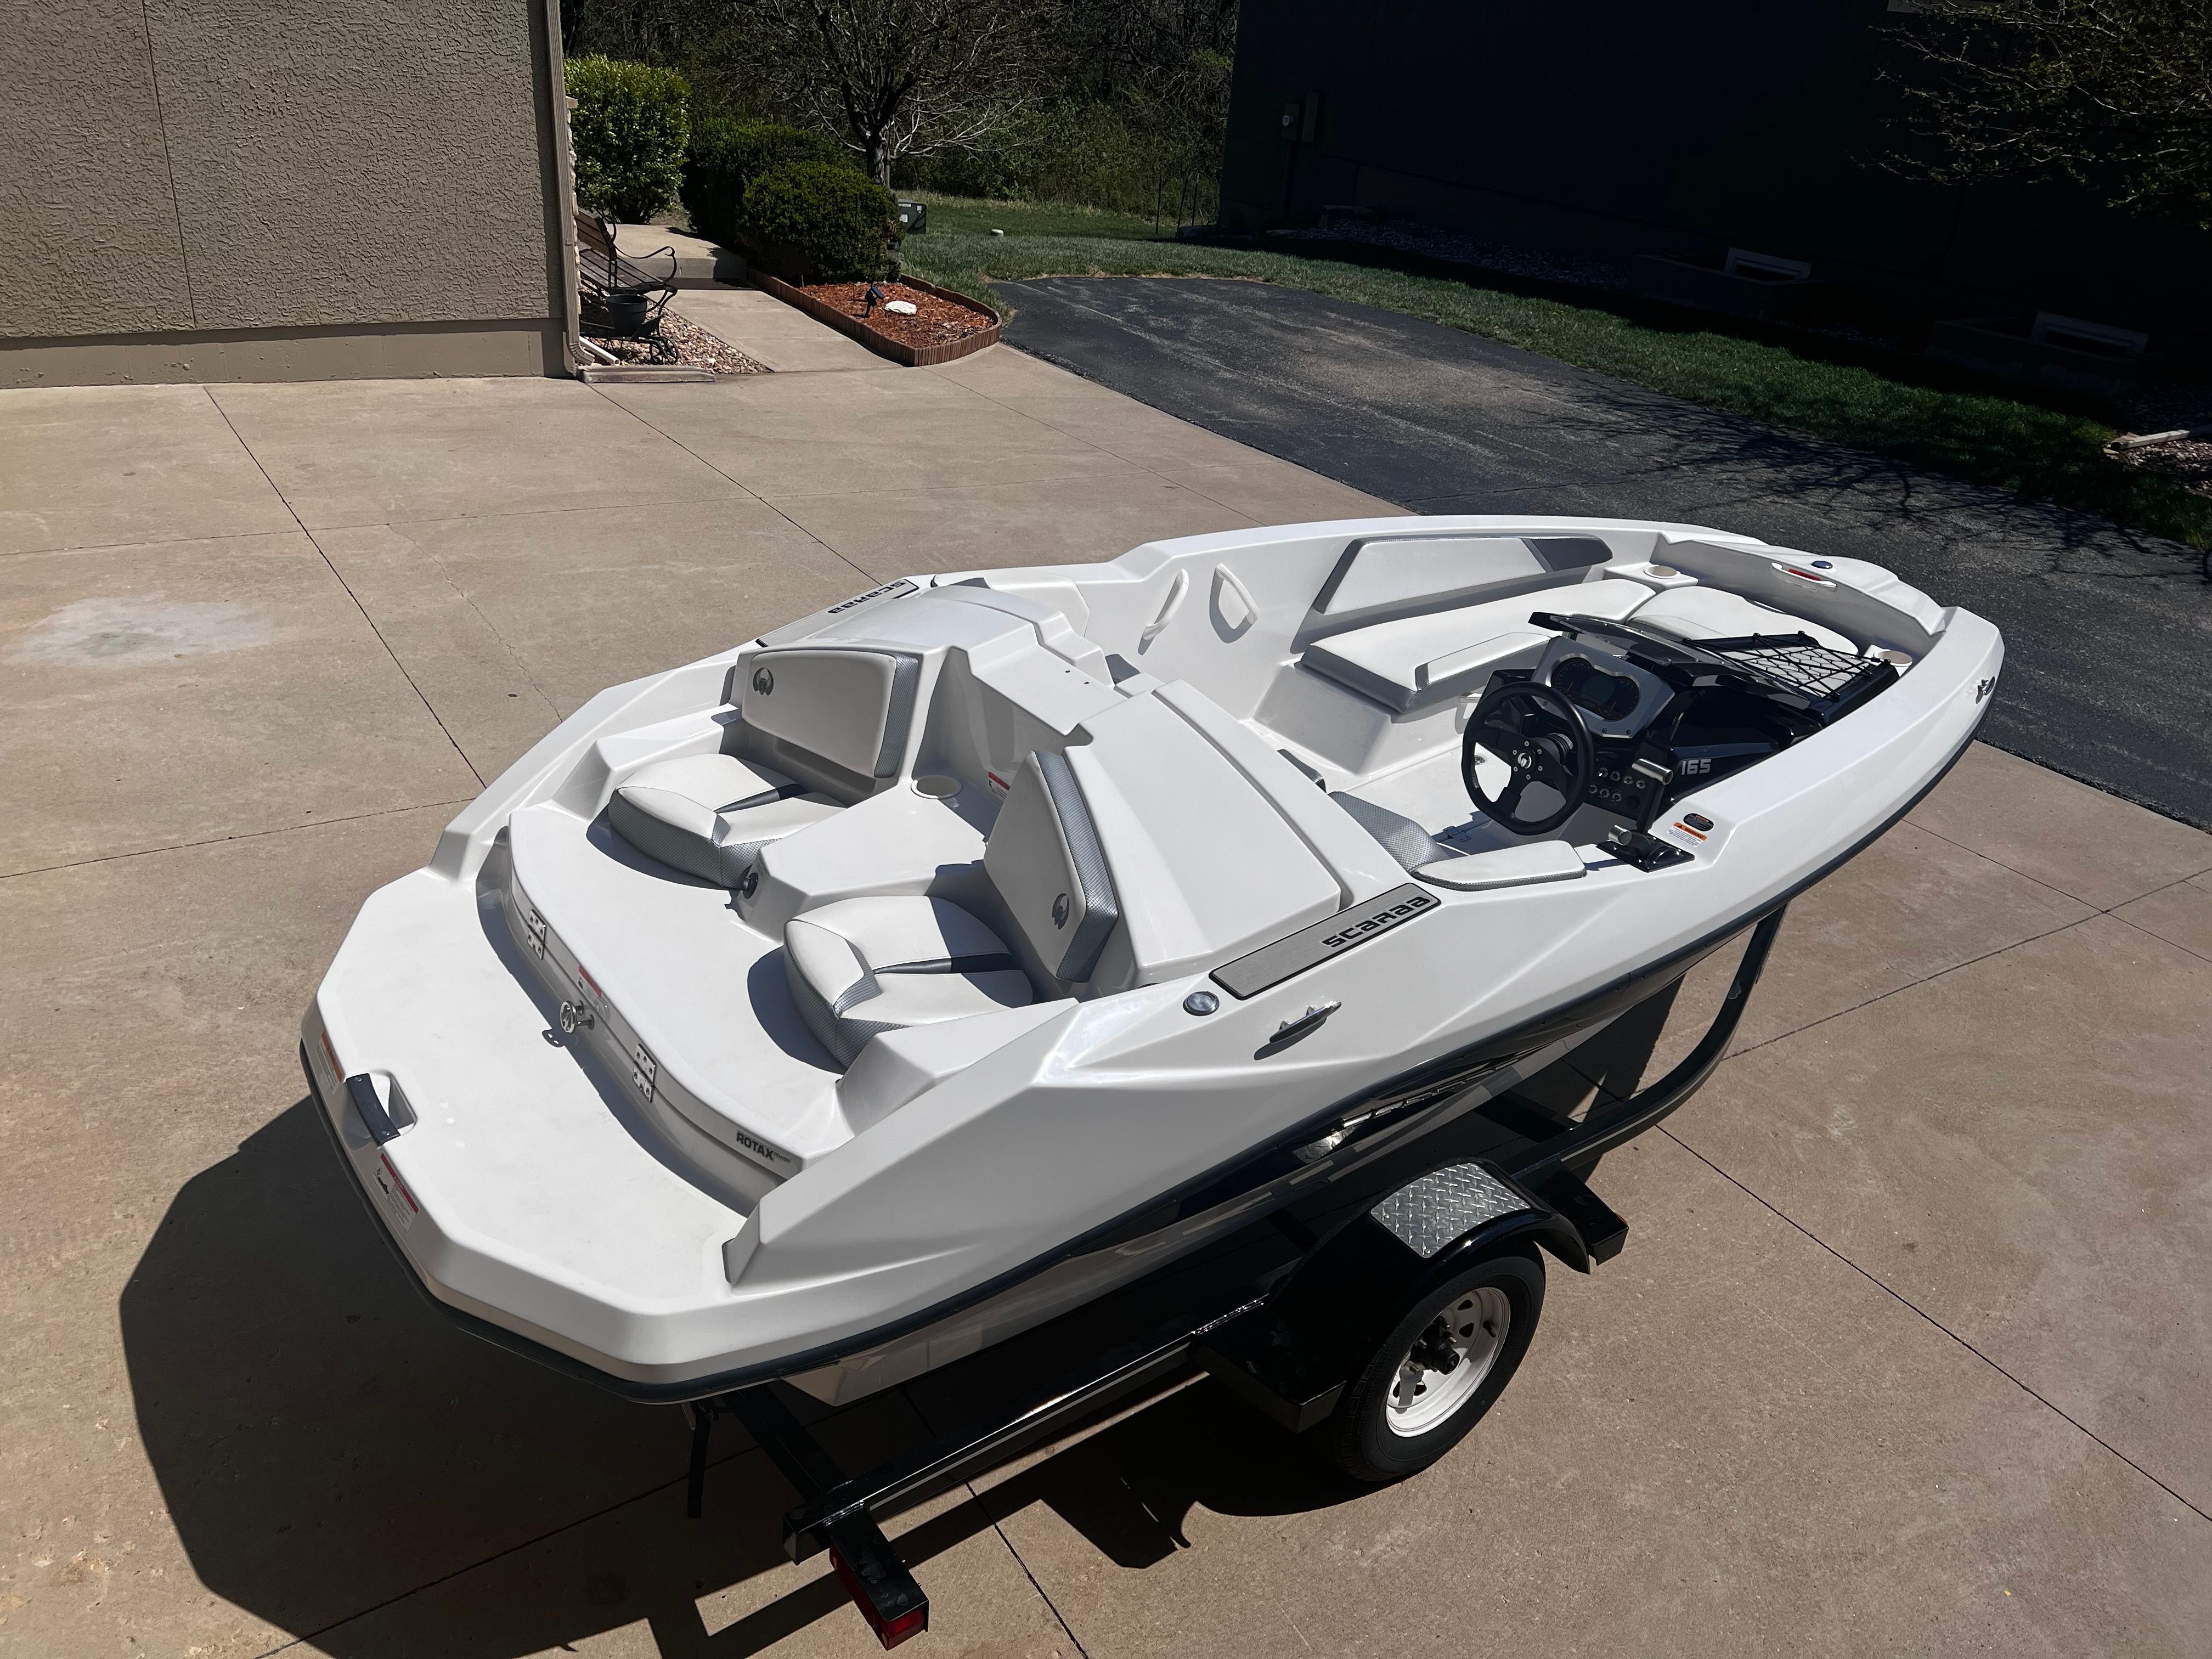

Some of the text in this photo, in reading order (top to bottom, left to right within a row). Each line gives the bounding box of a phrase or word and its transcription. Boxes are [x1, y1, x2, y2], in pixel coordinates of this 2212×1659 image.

[1681, 759, 1712, 776] 165
[1322, 896, 1431, 947] SCARAB
[736, 1131, 790, 1164] ROTAX POWER
